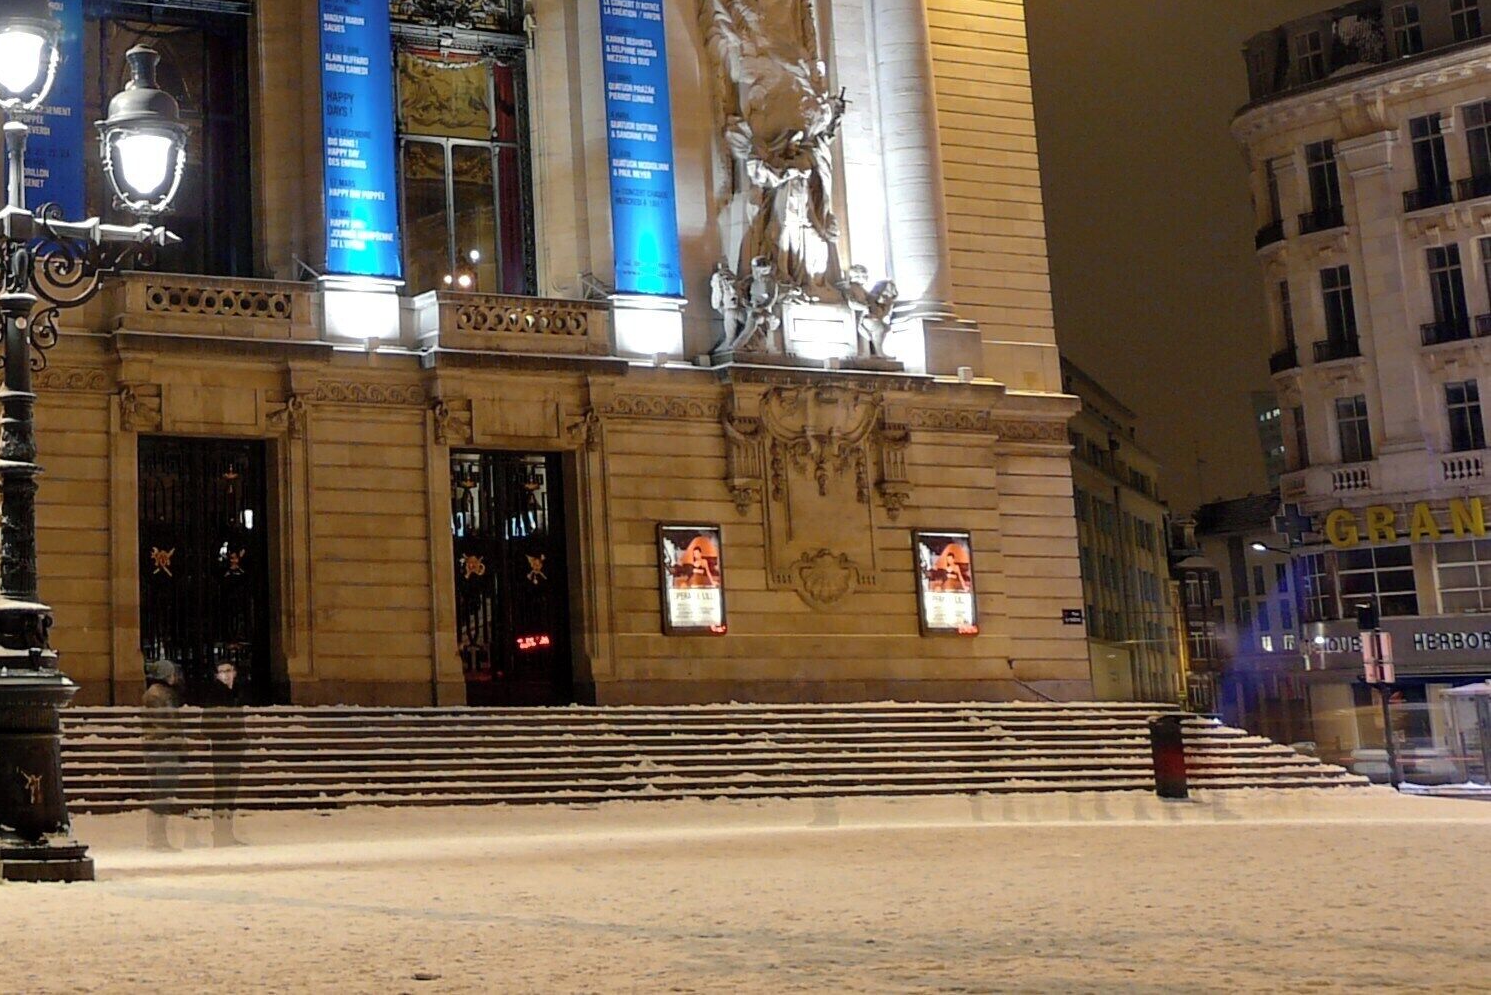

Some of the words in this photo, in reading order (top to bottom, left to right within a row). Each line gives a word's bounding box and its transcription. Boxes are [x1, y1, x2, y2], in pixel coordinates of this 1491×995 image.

[327, 91, 355, 104] HAPPY
[327, 104, 348, 117] DAYS
[327, 147, 348, 157] HAPPY
[329, 187, 349, 198] HAPPY
[1326, 497, 1485, 548] GRAN
